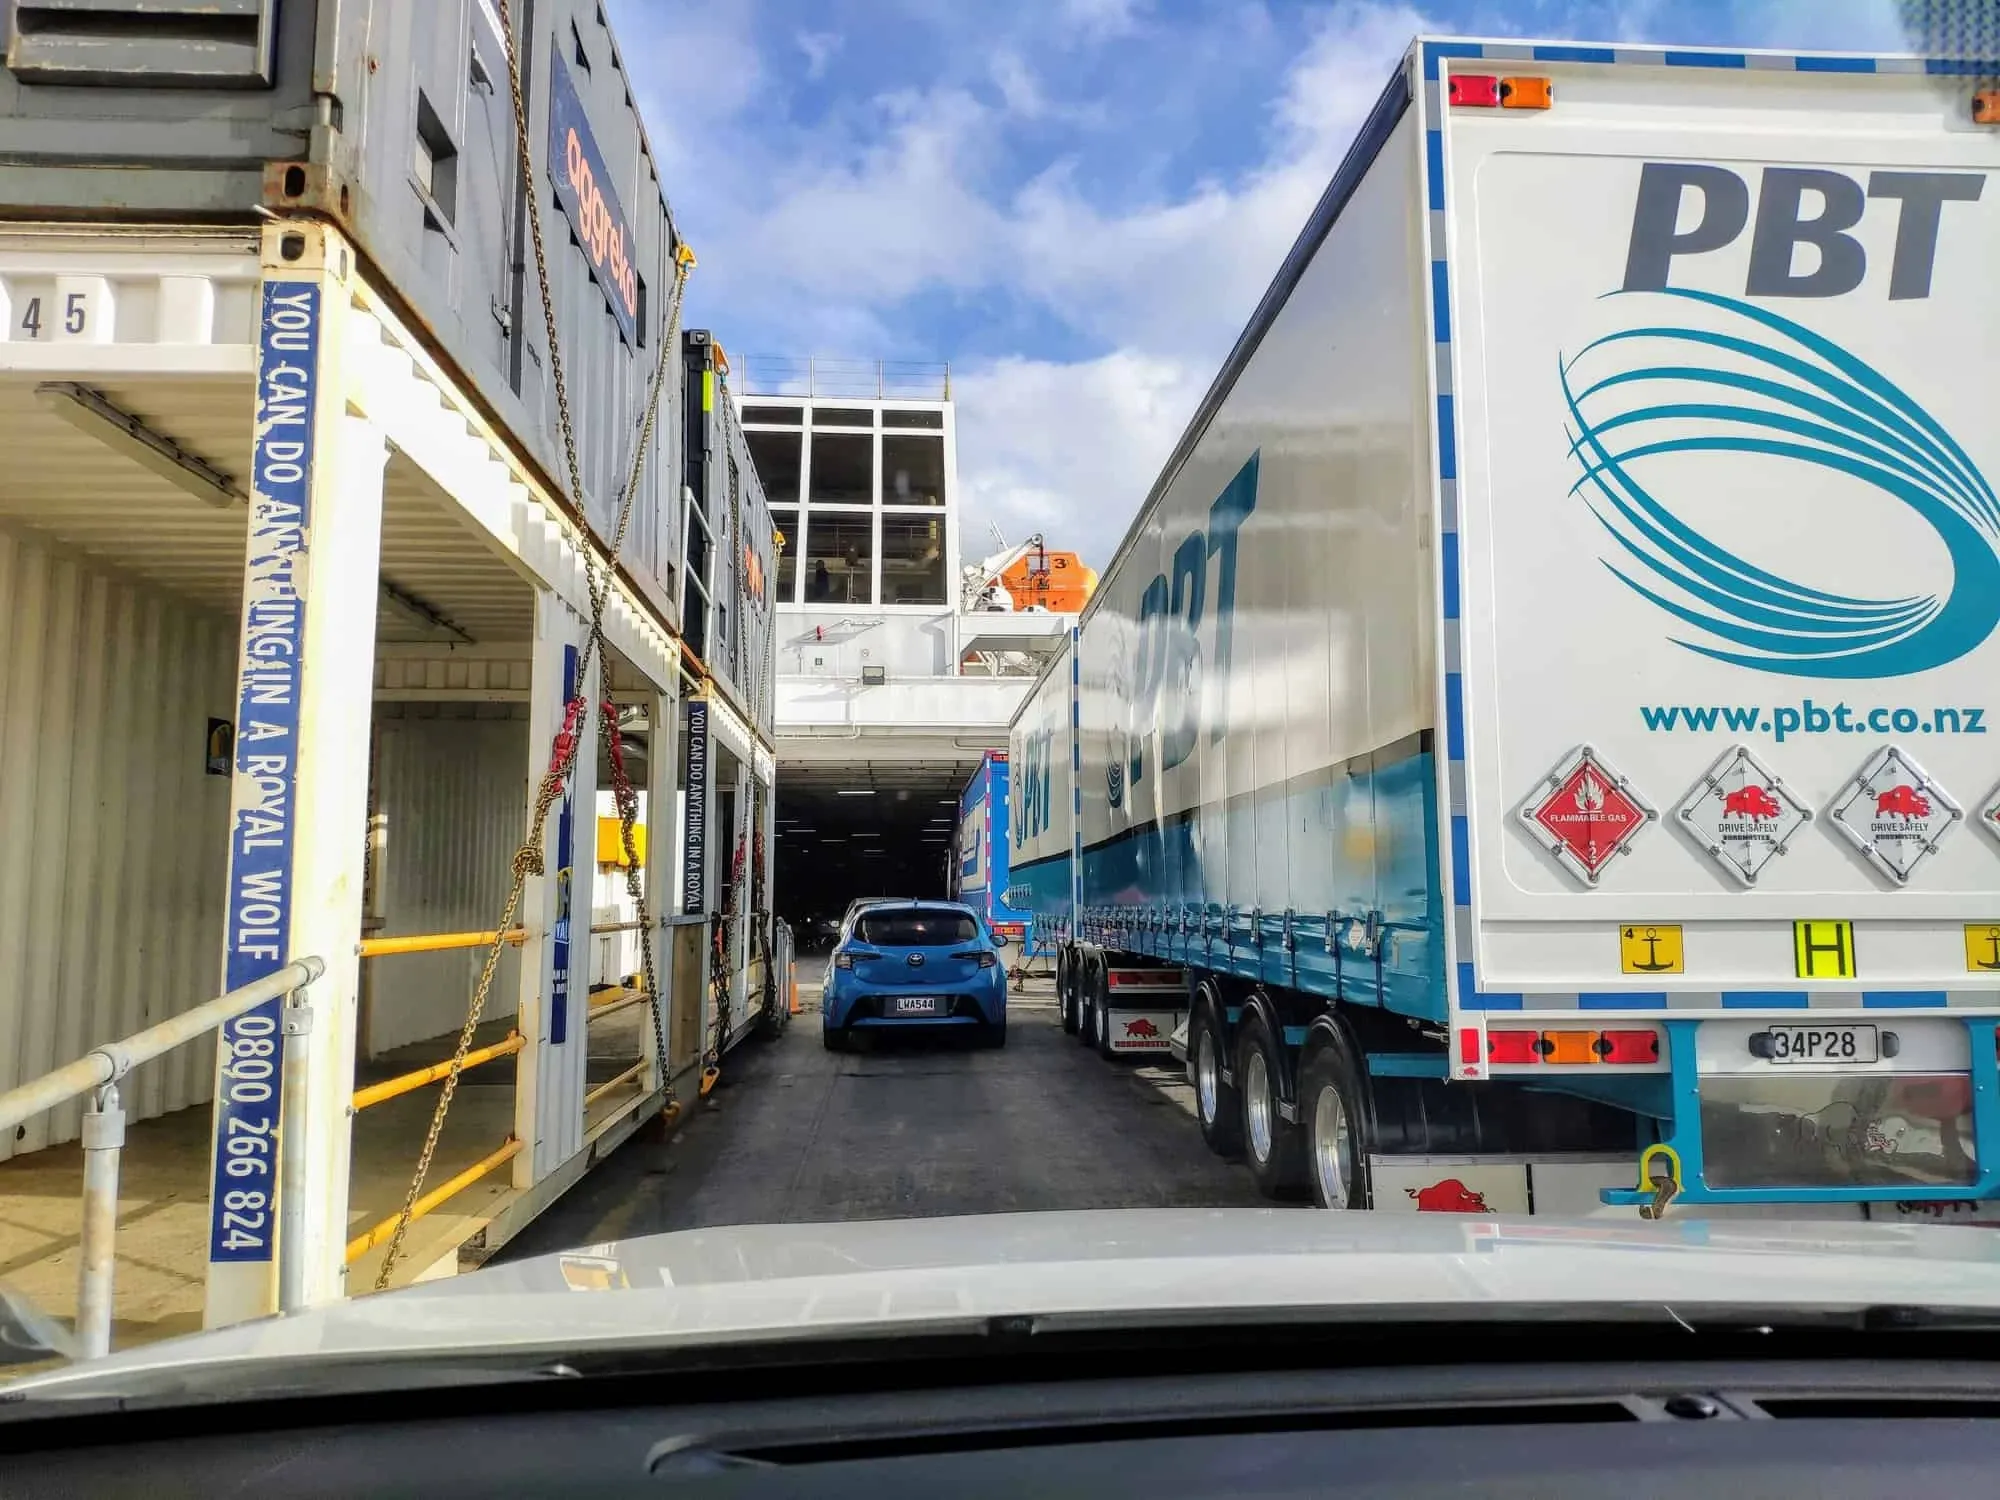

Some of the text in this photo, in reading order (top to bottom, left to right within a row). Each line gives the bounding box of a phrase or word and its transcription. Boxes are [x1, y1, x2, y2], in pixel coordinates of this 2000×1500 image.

[566, 126, 636, 317] aggreko
[1622, 161, 1988, 301] PBT
[269, 291, 312, 351] YOU
[267, 366, 309, 425] CAN
[263, 442, 305, 484] DO
[1053, 558, 1067, 569] 3
[250, 673, 292, 705] IN
[248, 719, 290, 742] A
[1639, 699, 1988, 743] www.pbt.co.nz
[242, 755, 289, 856] ROYAL
[687, 710, 705, 910] YOU CAN DO ANYTHING IN A ROYAL
[1549, 813, 1627, 823] FLAMMABLE GAS
[1718, 823, 1778, 833] DRIVE SAFELY
[1870, 822, 1929, 832] DRIVE SAFELY
[237, 868, 284, 961] WOLF
[1624, 928, 1634, 940] 4
[1804, 923, 1847, 977] H
[897, 998, 934, 1010] LWA544
[230, 1015, 277, 1103] 0800
[1774, 1030, 1857, 1059] 34P28
[226, 1116, 271, 1177] 266
[221, 1190, 267, 1251] 824
